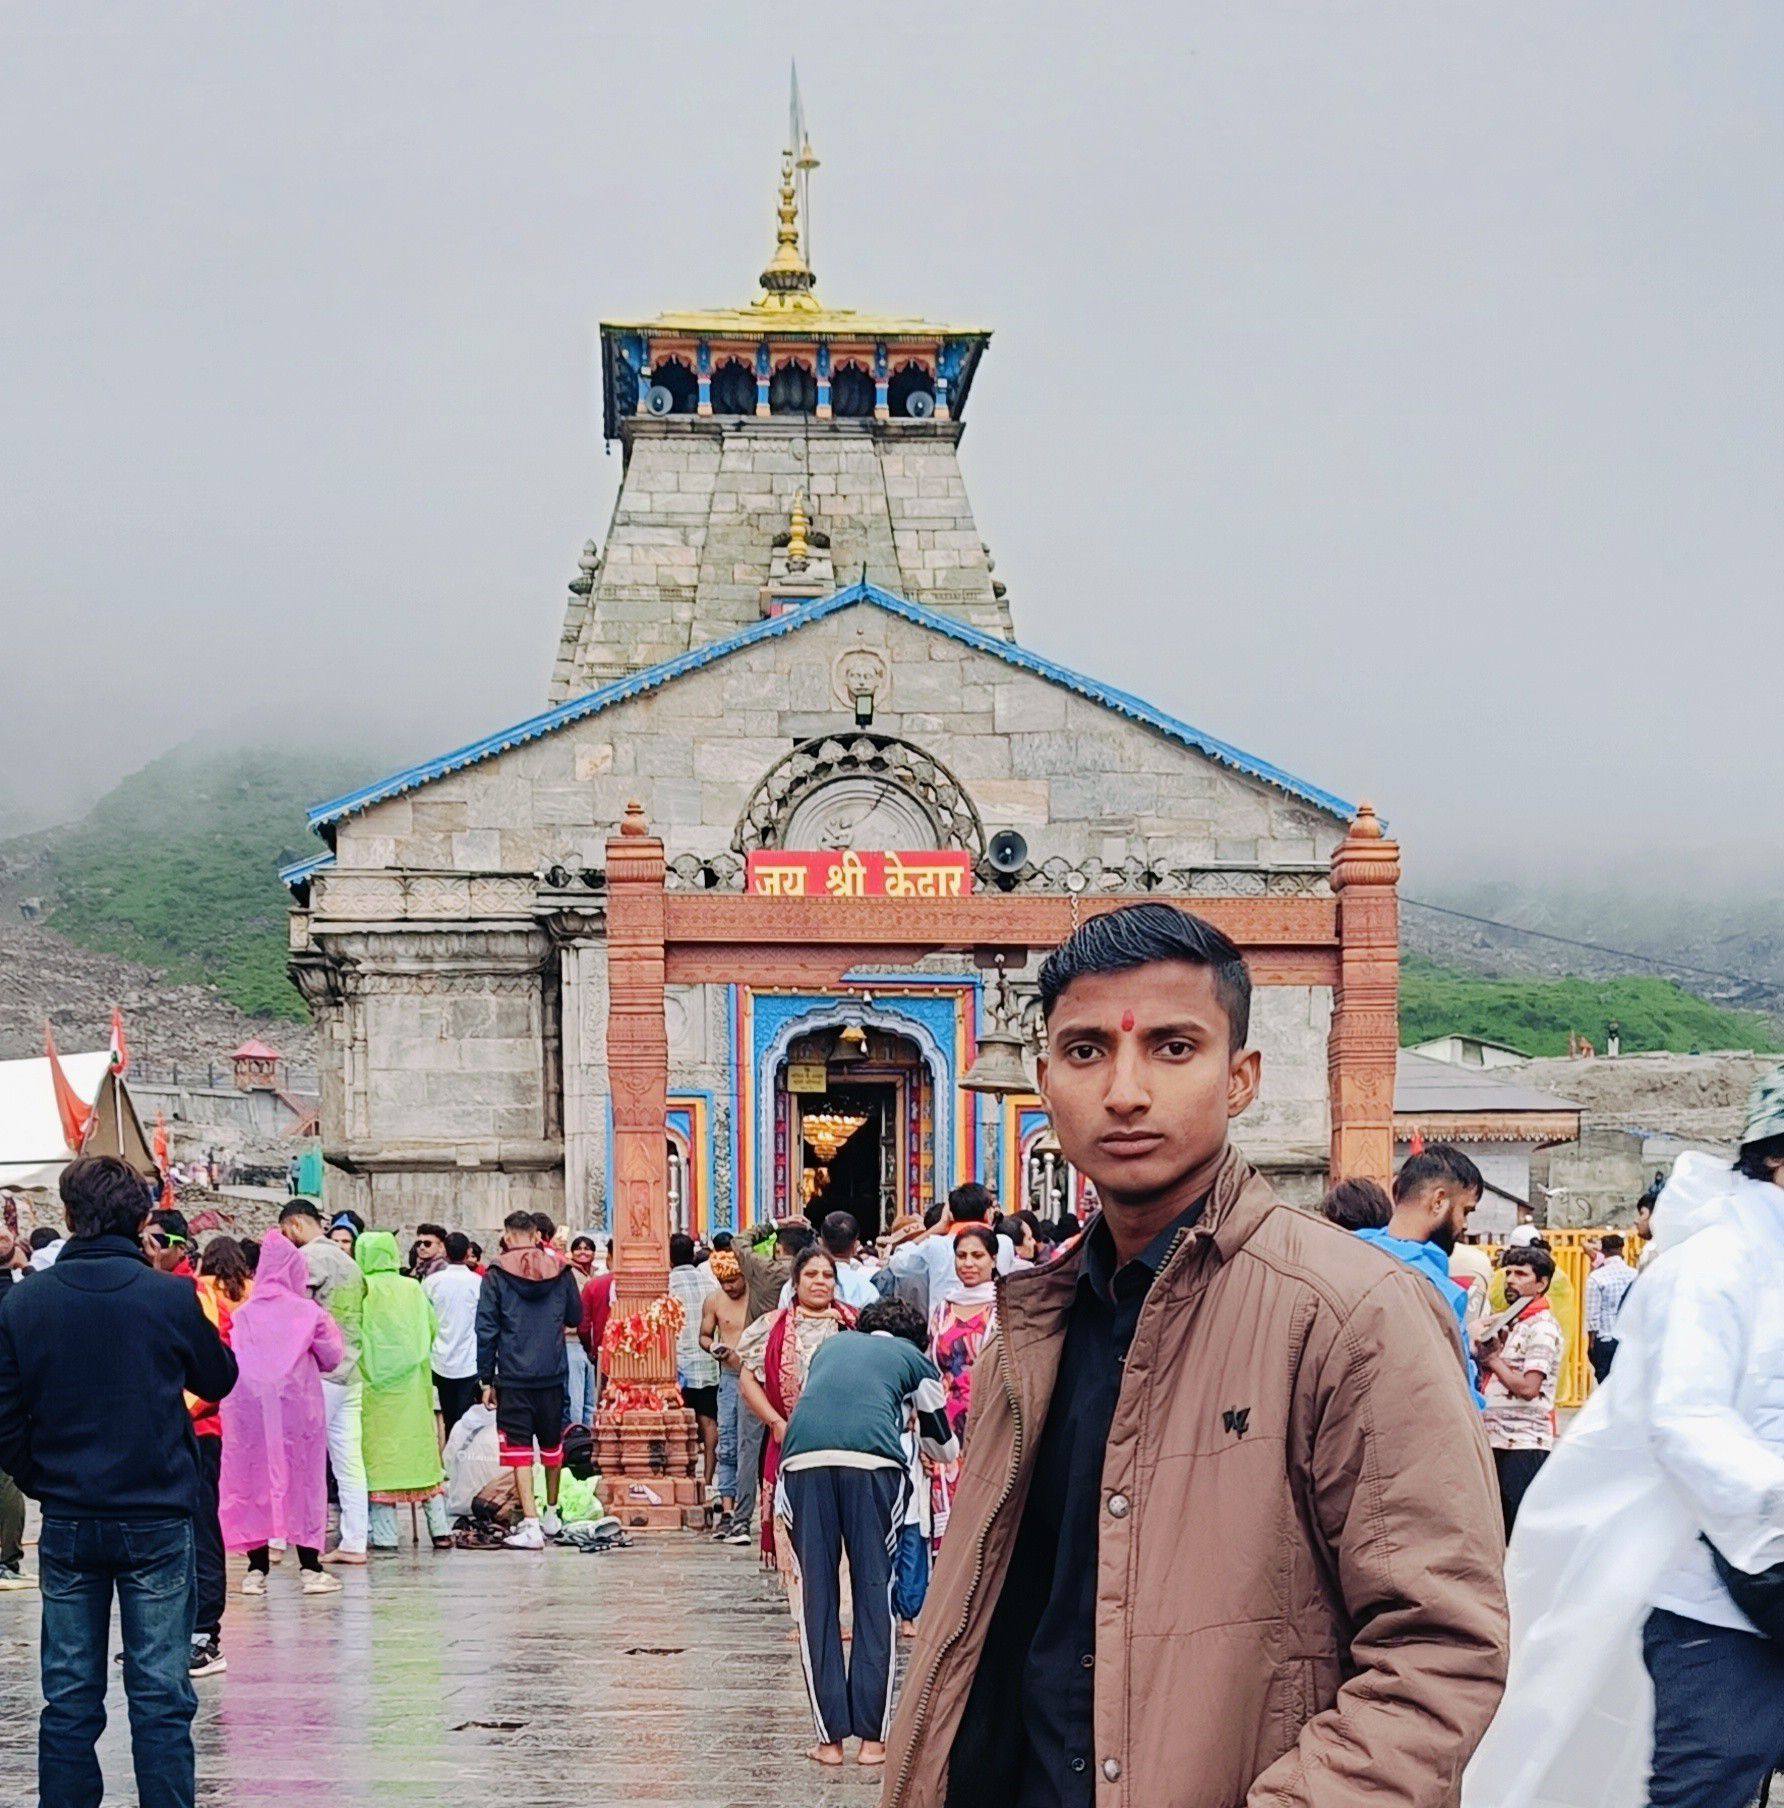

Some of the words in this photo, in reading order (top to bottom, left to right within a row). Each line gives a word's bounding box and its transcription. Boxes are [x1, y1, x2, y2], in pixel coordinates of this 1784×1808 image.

[754, 865, 807, 896] जय
[825, 850, 868, 897] श्री
[884, 849, 964, 897] केदार
